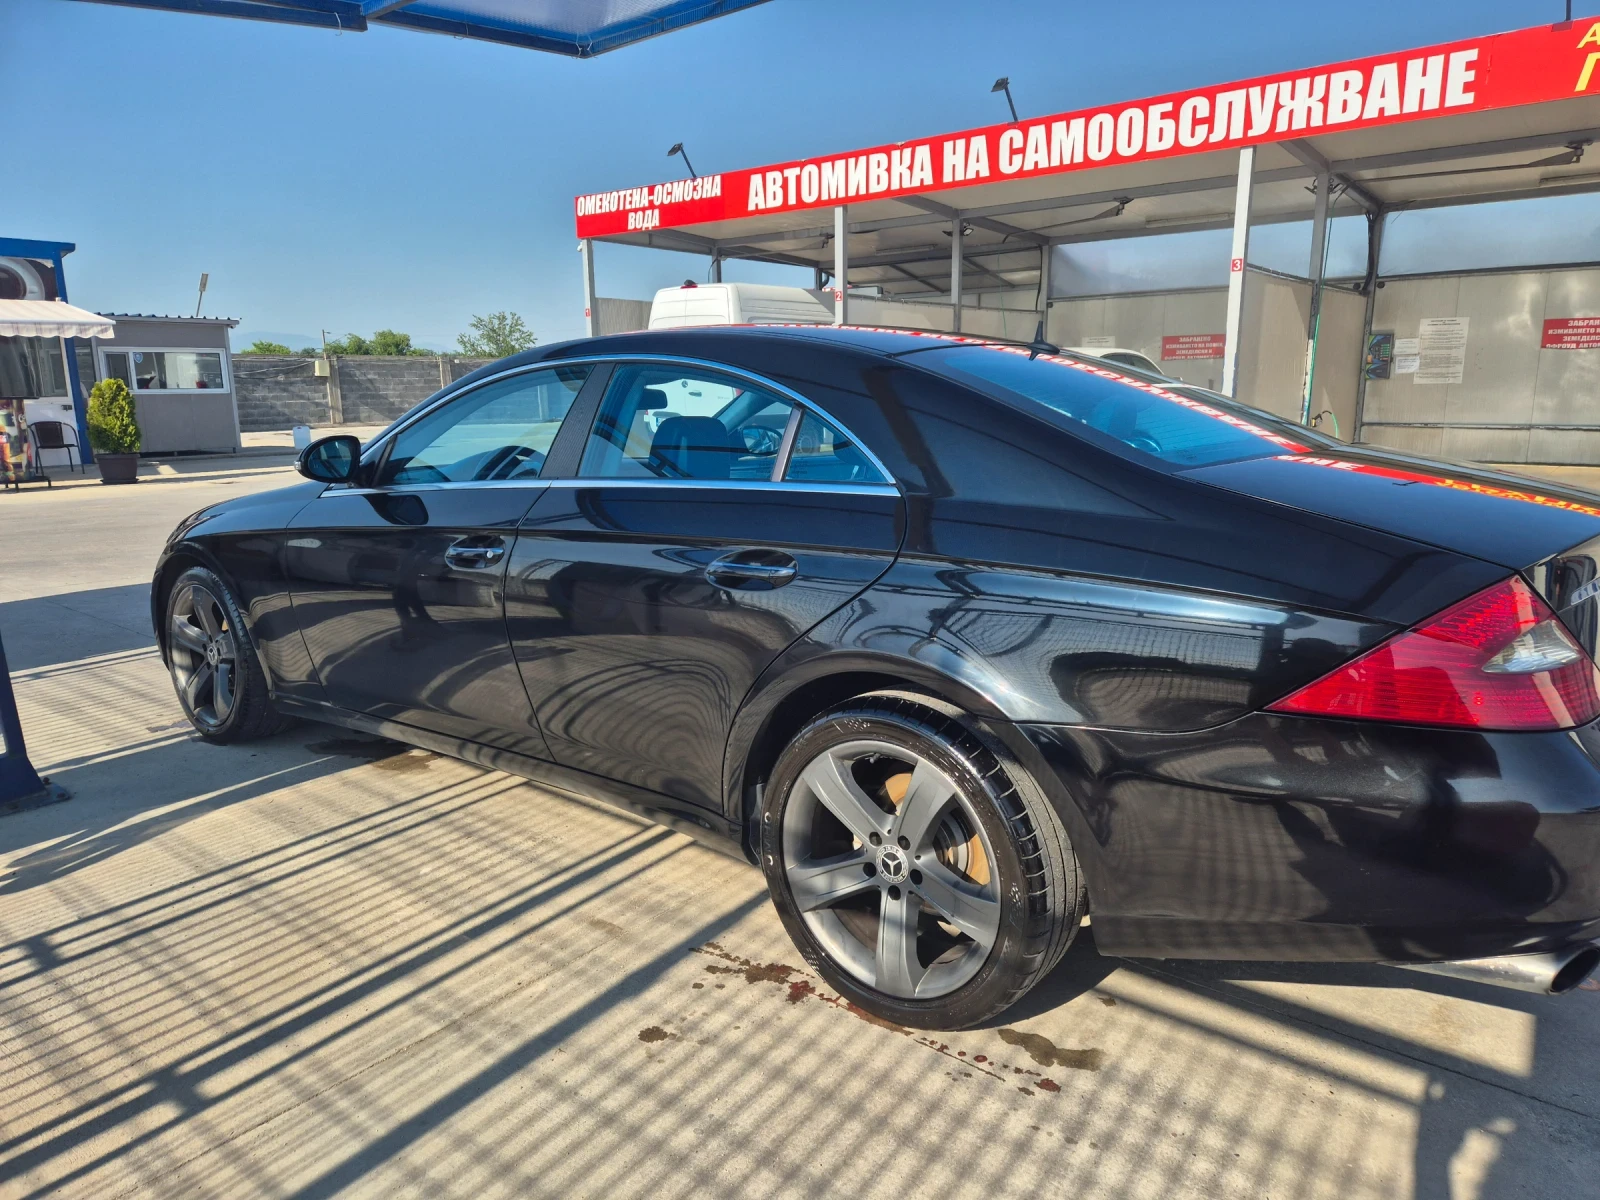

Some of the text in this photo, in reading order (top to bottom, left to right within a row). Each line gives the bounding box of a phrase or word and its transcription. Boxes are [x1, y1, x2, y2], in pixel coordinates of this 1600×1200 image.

[747, 48, 1479, 211] АВТОМИВКА НА САМООБСЛУЖВАНЕ
[577, 174, 721, 216] ОМЕКОТЕНА-ОСМОЗНА
[627, 208, 660, 231] ВОДА
[1233, 259, 1241, 271] 3
